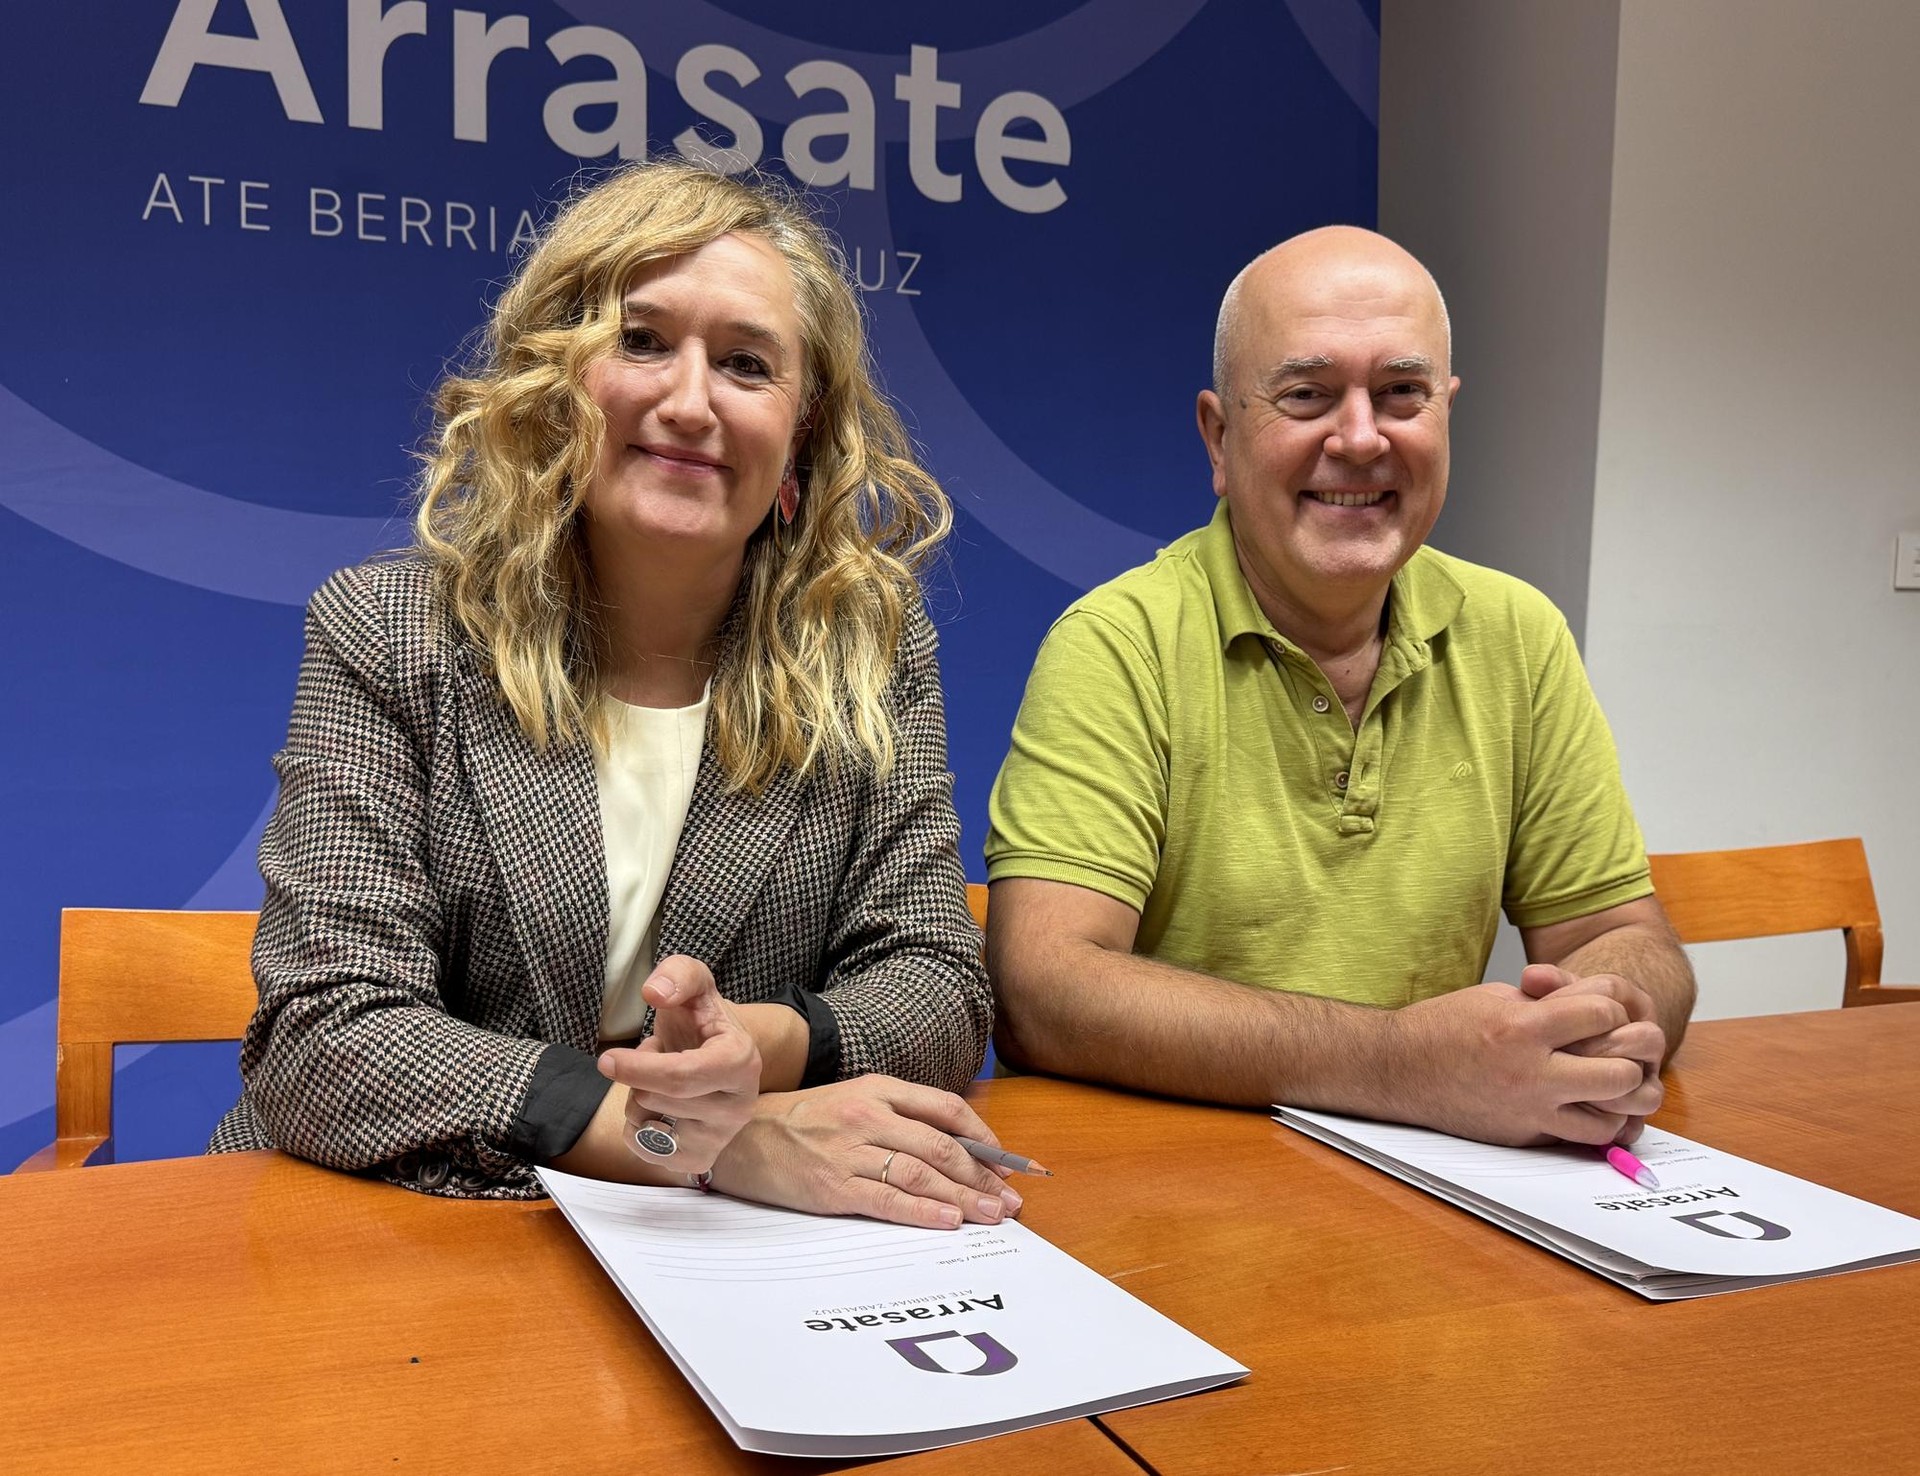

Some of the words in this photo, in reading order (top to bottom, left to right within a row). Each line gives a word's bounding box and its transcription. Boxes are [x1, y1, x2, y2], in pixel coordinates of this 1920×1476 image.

[138, 0, 1072, 214] Arrasate
[142, 172, 271, 231] ATE
[309, 187, 543, 255] BERRIA
[1594, 1186, 1740, 1211] Arrasate
[889, 1294, 946, 1307] BERRIAK
[948, 1289, 973, 1299] ATE
[803, 1293, 1005, 1332] Arrasate
[812, 1303, 886, 1316] ZABALDUZ
